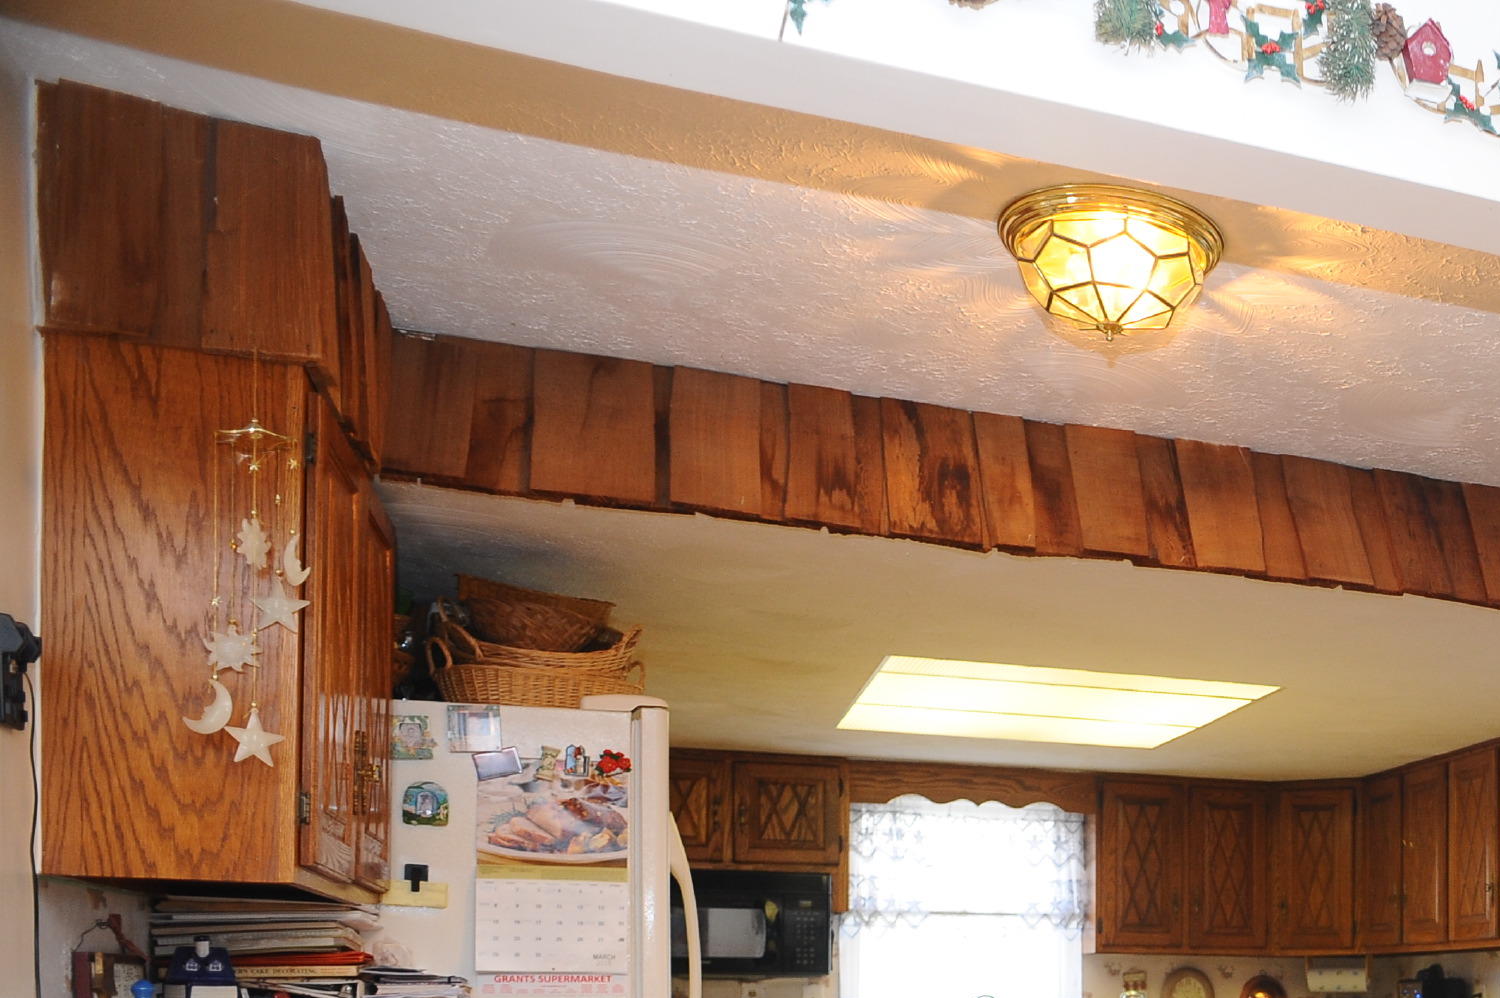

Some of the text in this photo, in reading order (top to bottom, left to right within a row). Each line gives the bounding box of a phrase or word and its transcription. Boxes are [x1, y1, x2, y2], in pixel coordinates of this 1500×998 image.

[592, 953, 616, 961] MARCH
[494, 974, 613, 984] GRANTS SUPERMARKET
